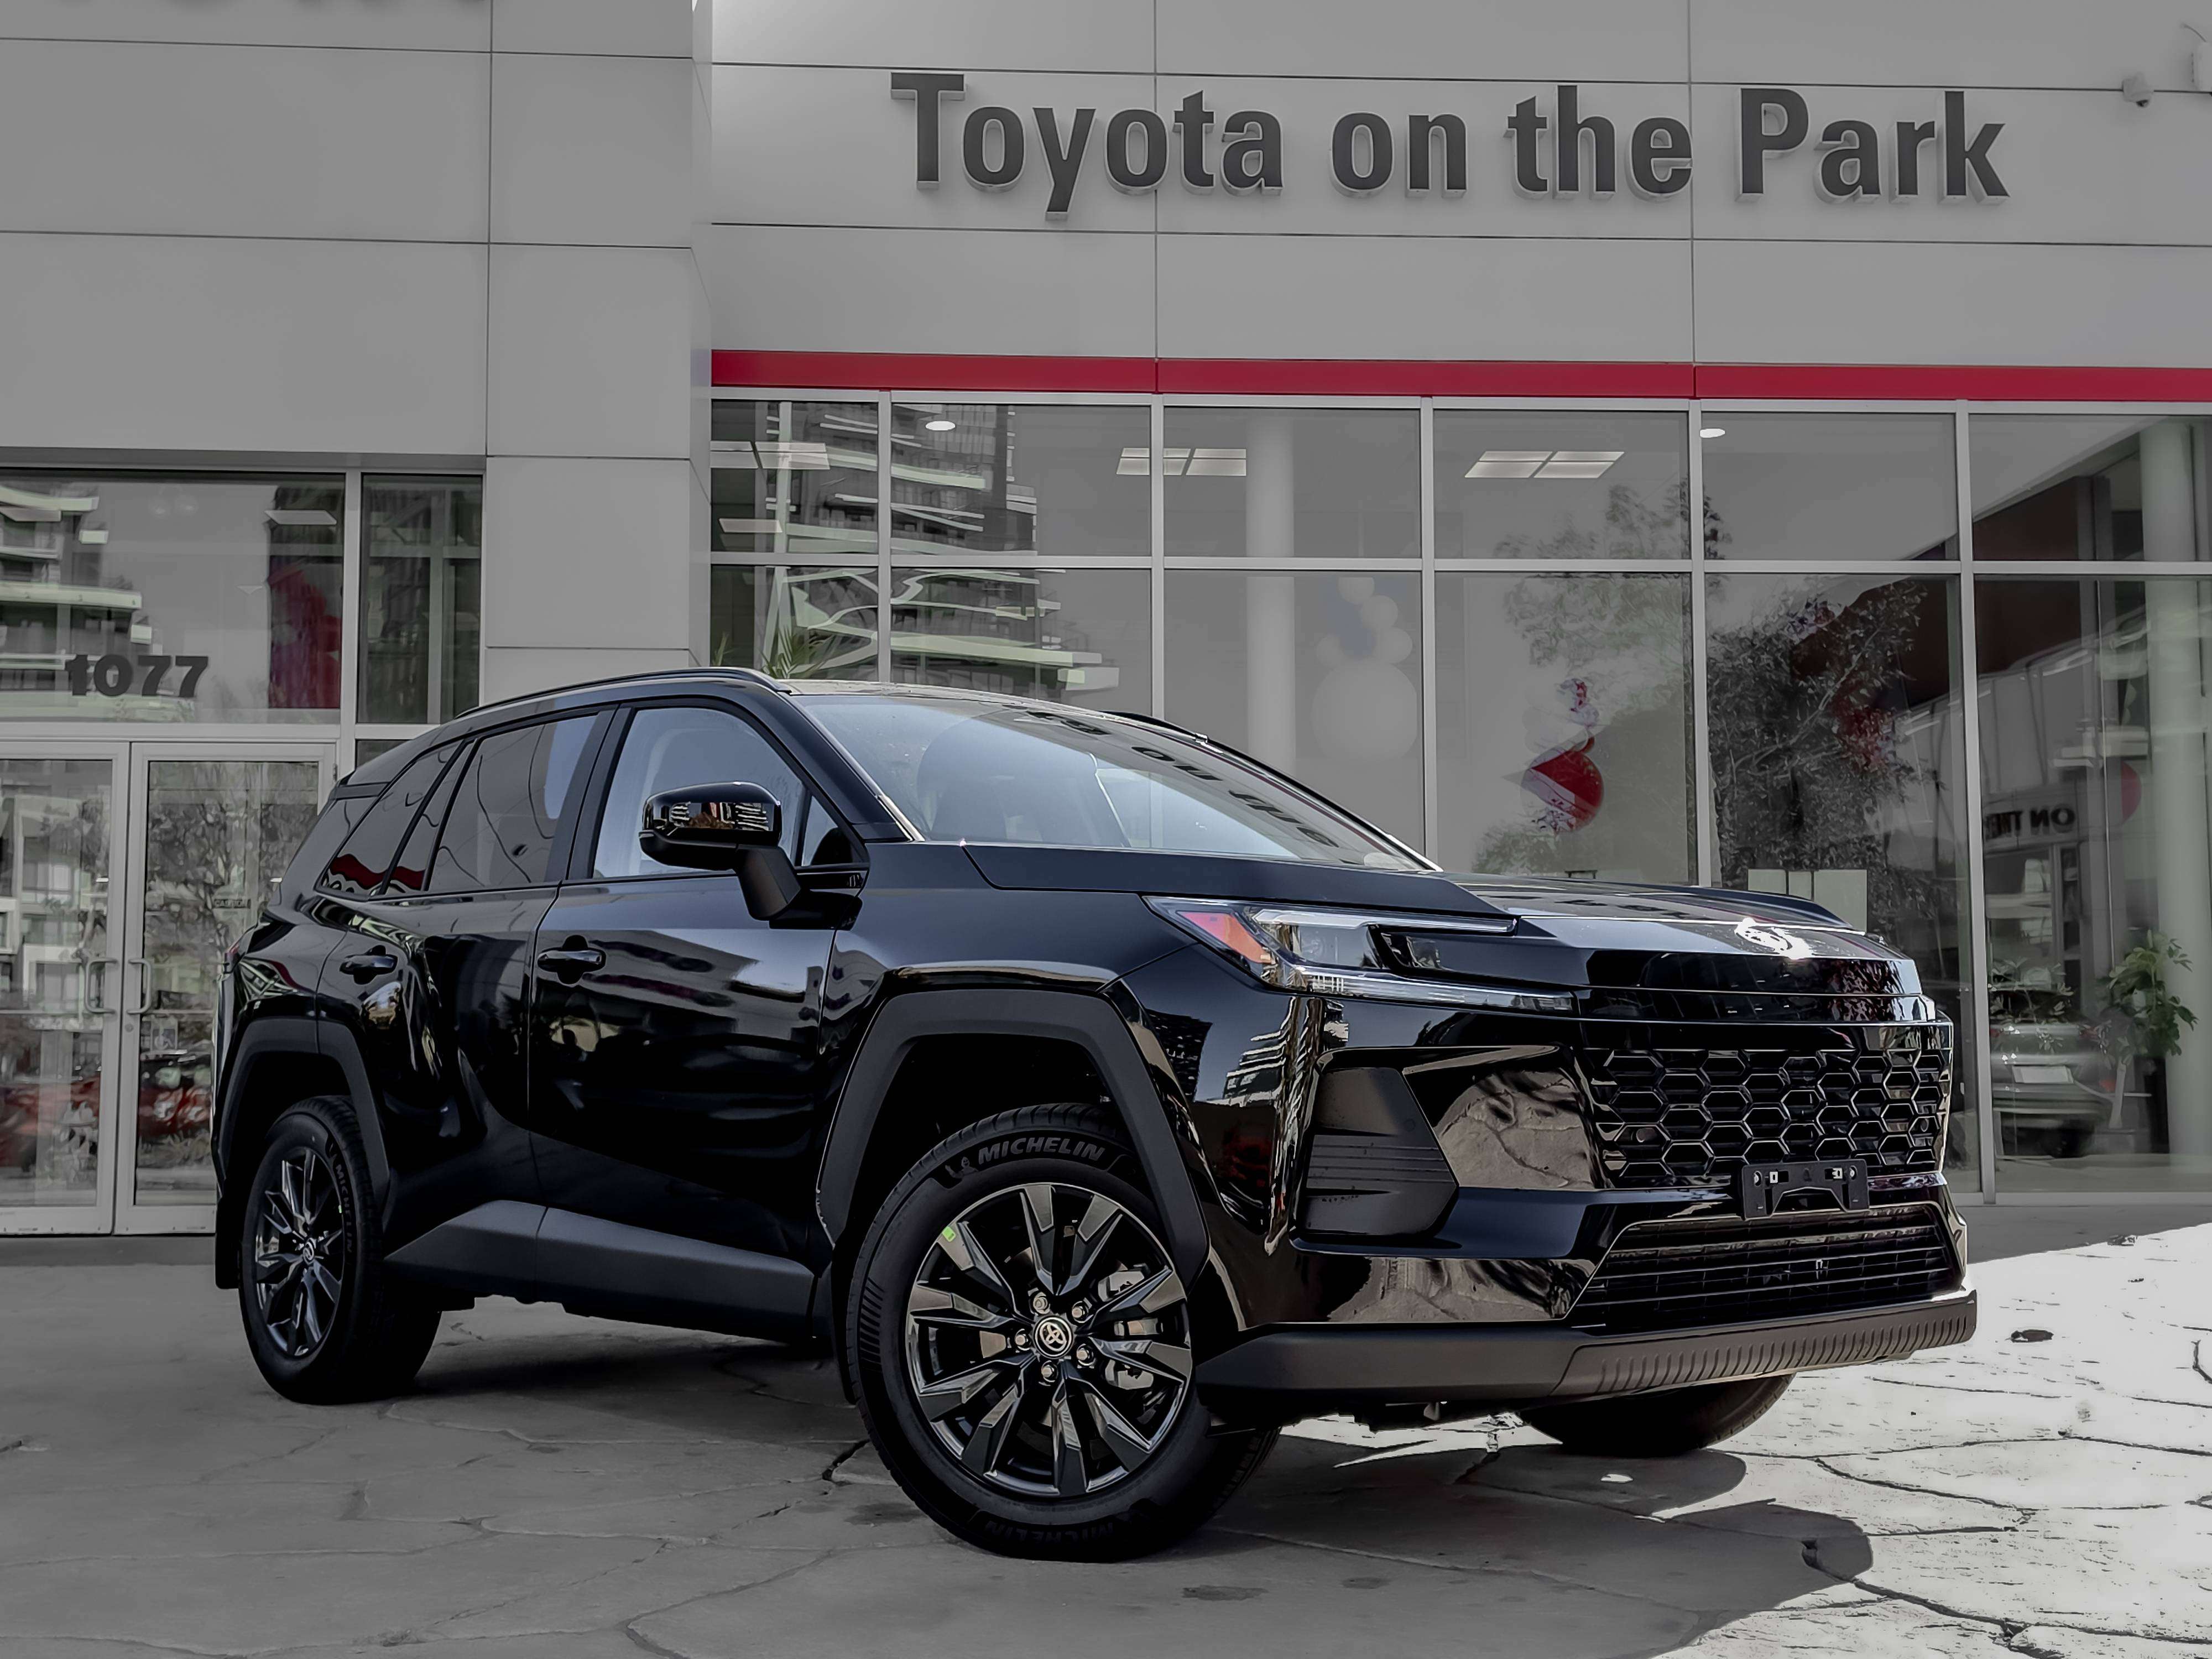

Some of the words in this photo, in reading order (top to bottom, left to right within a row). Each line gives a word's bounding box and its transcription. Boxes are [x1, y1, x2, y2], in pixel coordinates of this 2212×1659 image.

[890, 72, 1283, 215] Toyota
[1331, 112, 1468, 194] on
[1505, 85, 1693, 196] the
[1739, 88, 2010, 199] Park
[65, 654, 208, 697] 1077
[978, 1138, 1105, 1164] MICHELIN
[336, 1164, 352, 1253] MICHELIN
